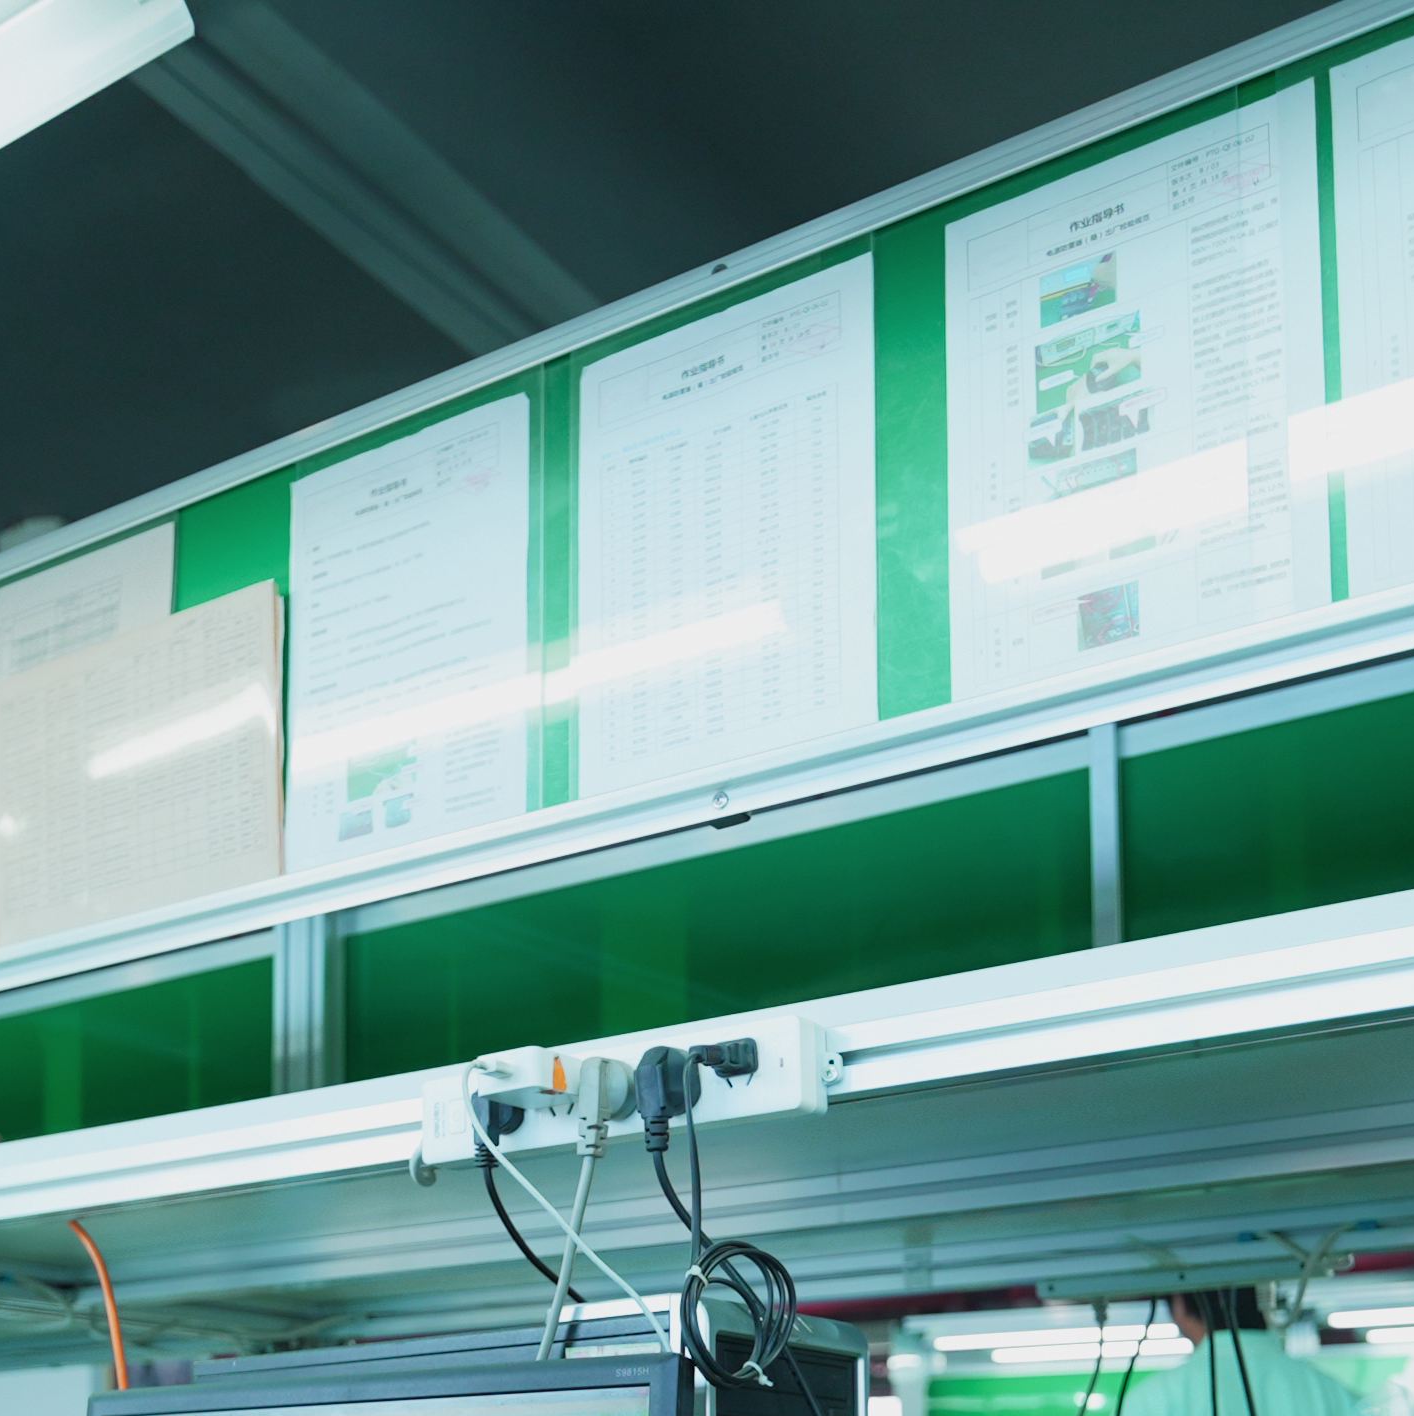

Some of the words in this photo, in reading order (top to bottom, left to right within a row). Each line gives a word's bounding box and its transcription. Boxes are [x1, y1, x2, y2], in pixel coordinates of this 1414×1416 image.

[1069, 203, 1125, 233] 作业指导书
